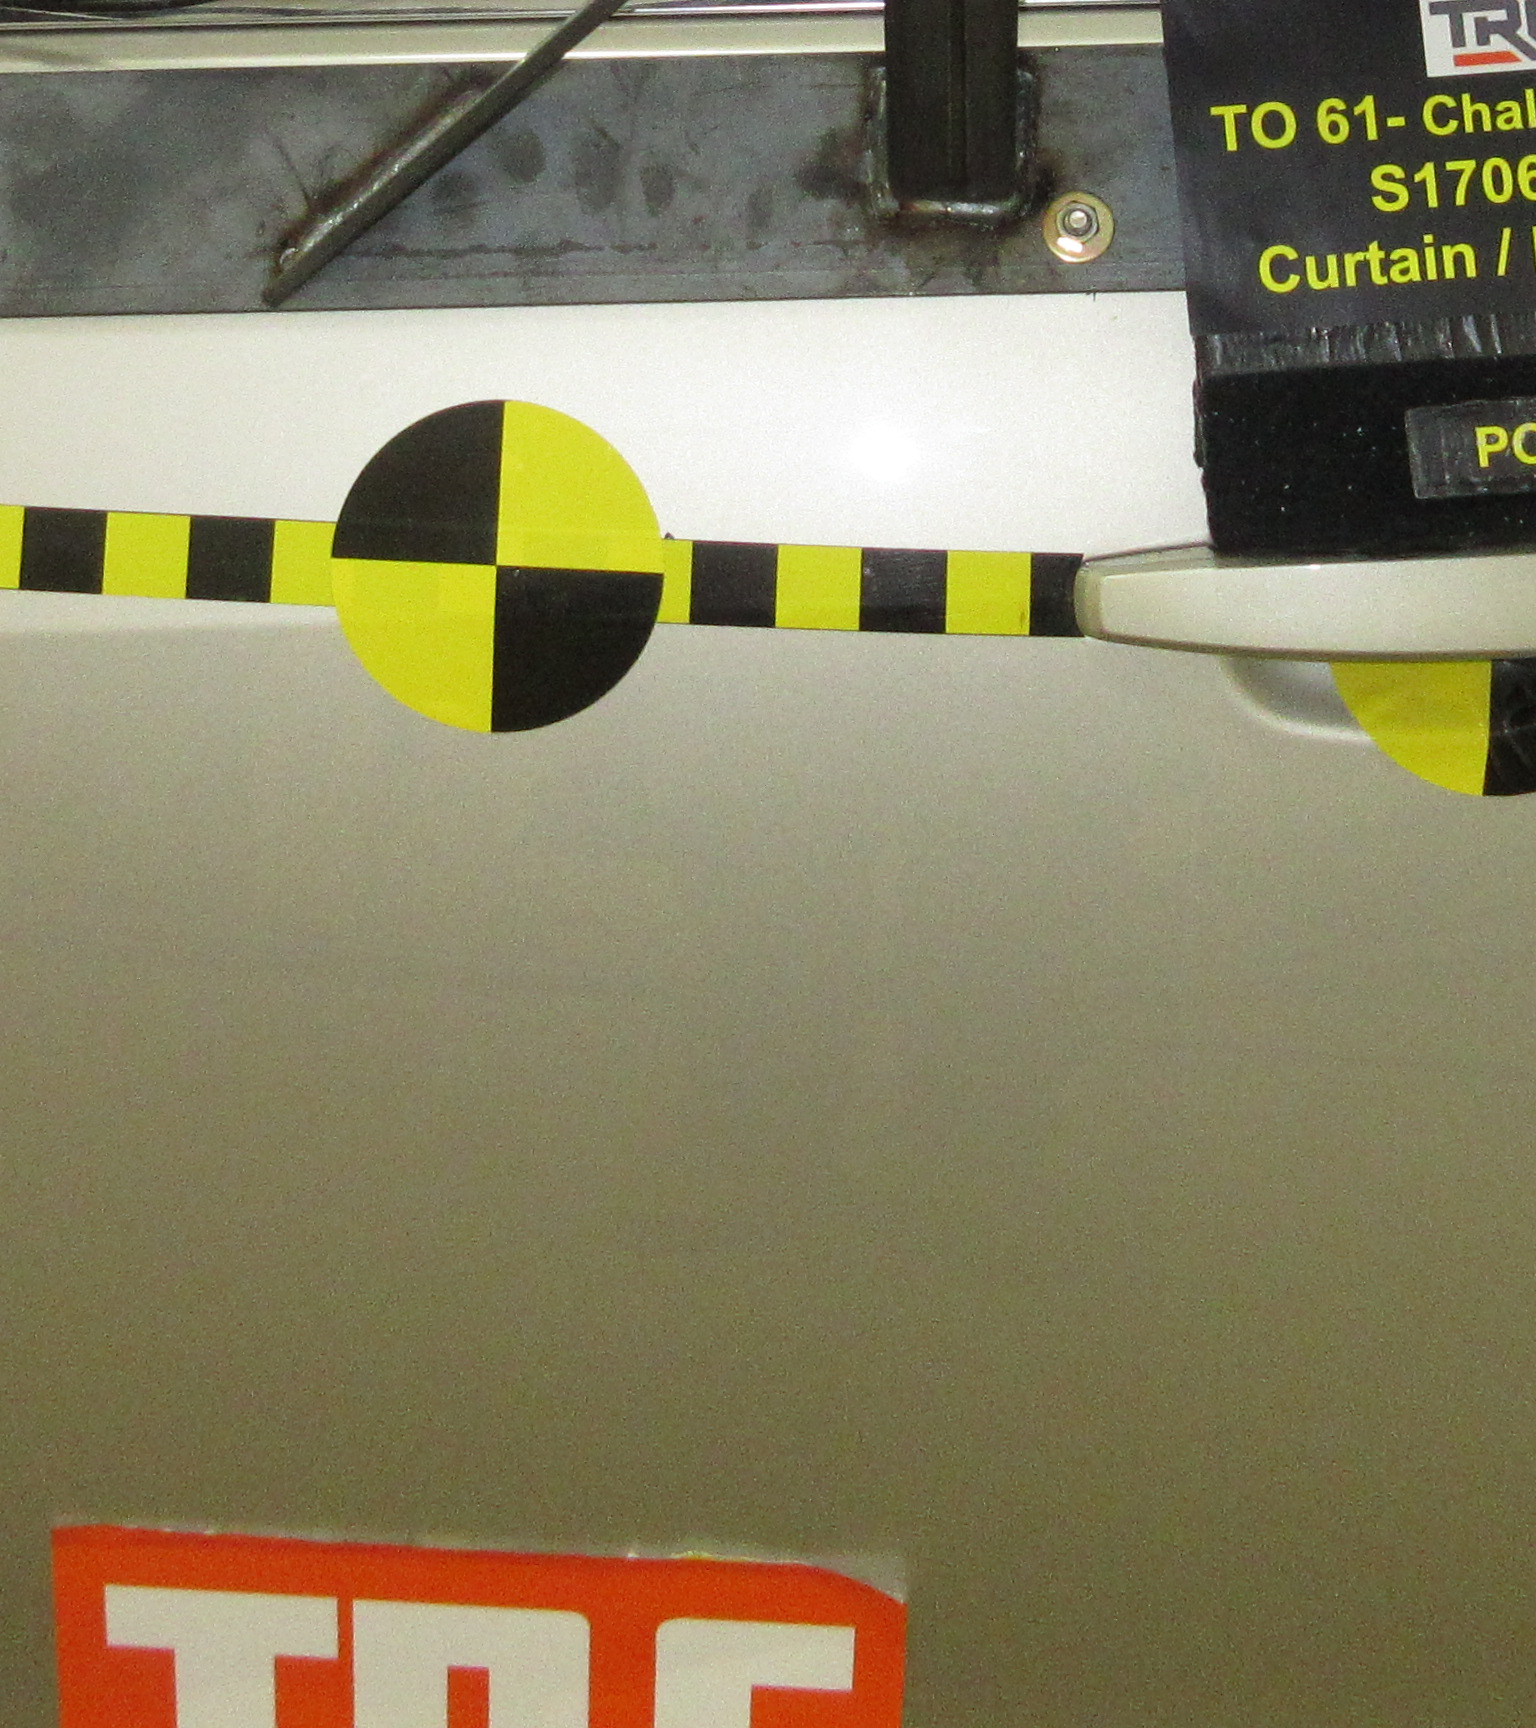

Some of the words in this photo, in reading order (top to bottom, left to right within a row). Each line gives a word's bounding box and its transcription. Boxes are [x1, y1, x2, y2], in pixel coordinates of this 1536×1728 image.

[1210, 102, 1297, 152] TO
[1317, 95, 1405, 144] 61-
[1258, 233, 1477, 293] Curtain
[1497, 227, 1512, 276] /
